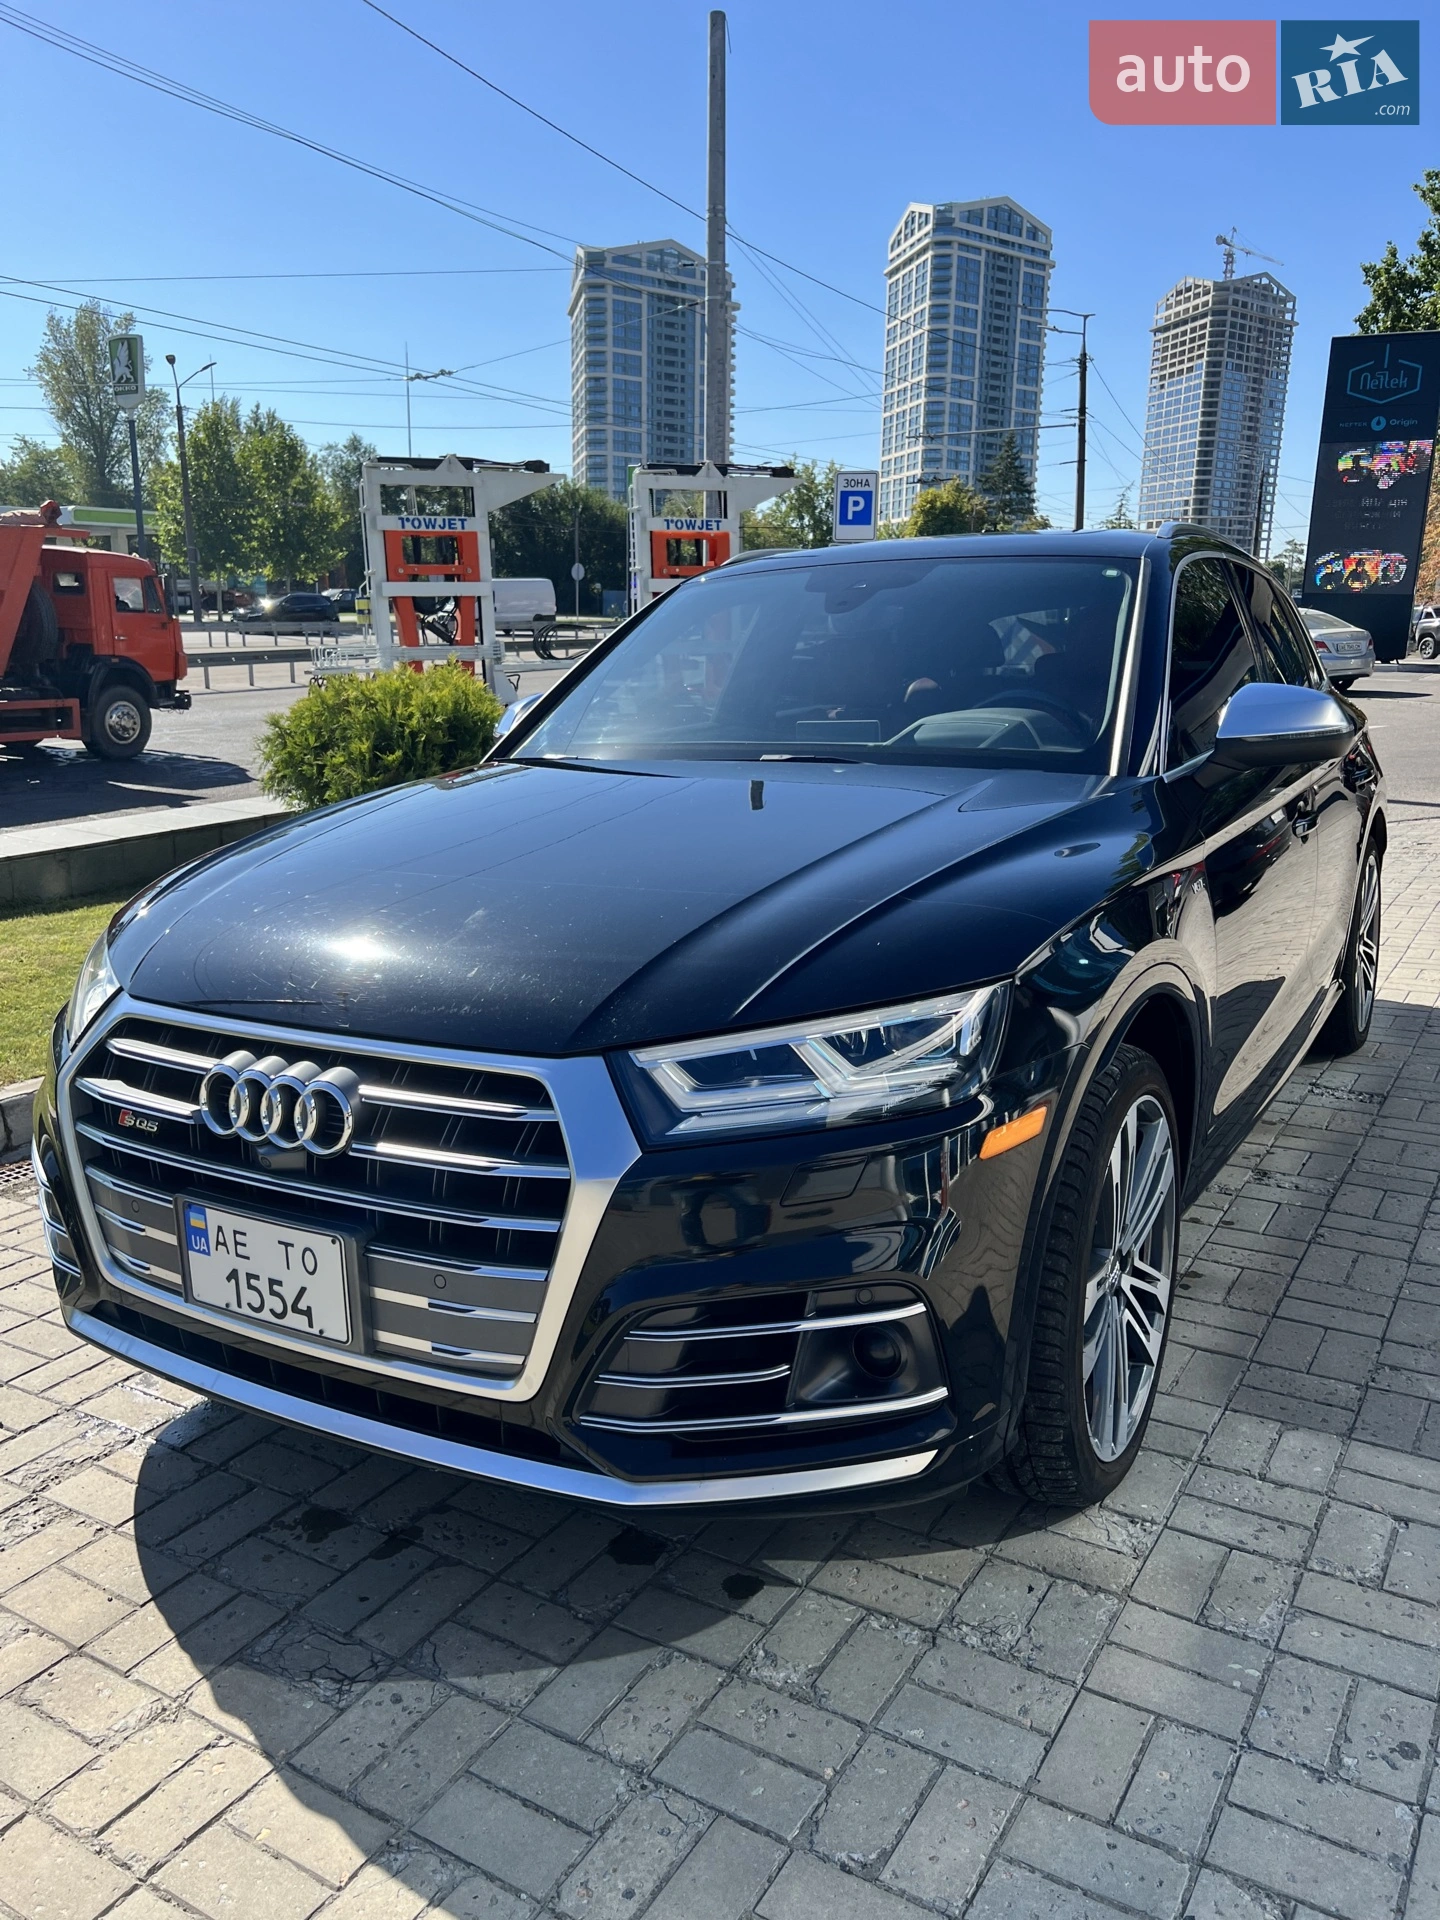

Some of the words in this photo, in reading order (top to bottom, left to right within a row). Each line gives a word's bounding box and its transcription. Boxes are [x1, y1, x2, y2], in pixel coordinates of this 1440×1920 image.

[1389, 418, 1418, 428] Origin
[843, 478, 871, 489] ЗОНА
[847, 495, 866, 521] P
[398, 516, 468, 531] TOWJET
[663, 518, 722, 531] TOWJET
[124, 1113, 159, 1132] SQ5
[191, 1234, 209, 1253] UA
[215, 1224, 251, 1261] AE
[277, 1239, 318, 1276] TO
[225, 1267, 314, 1329] 1554
